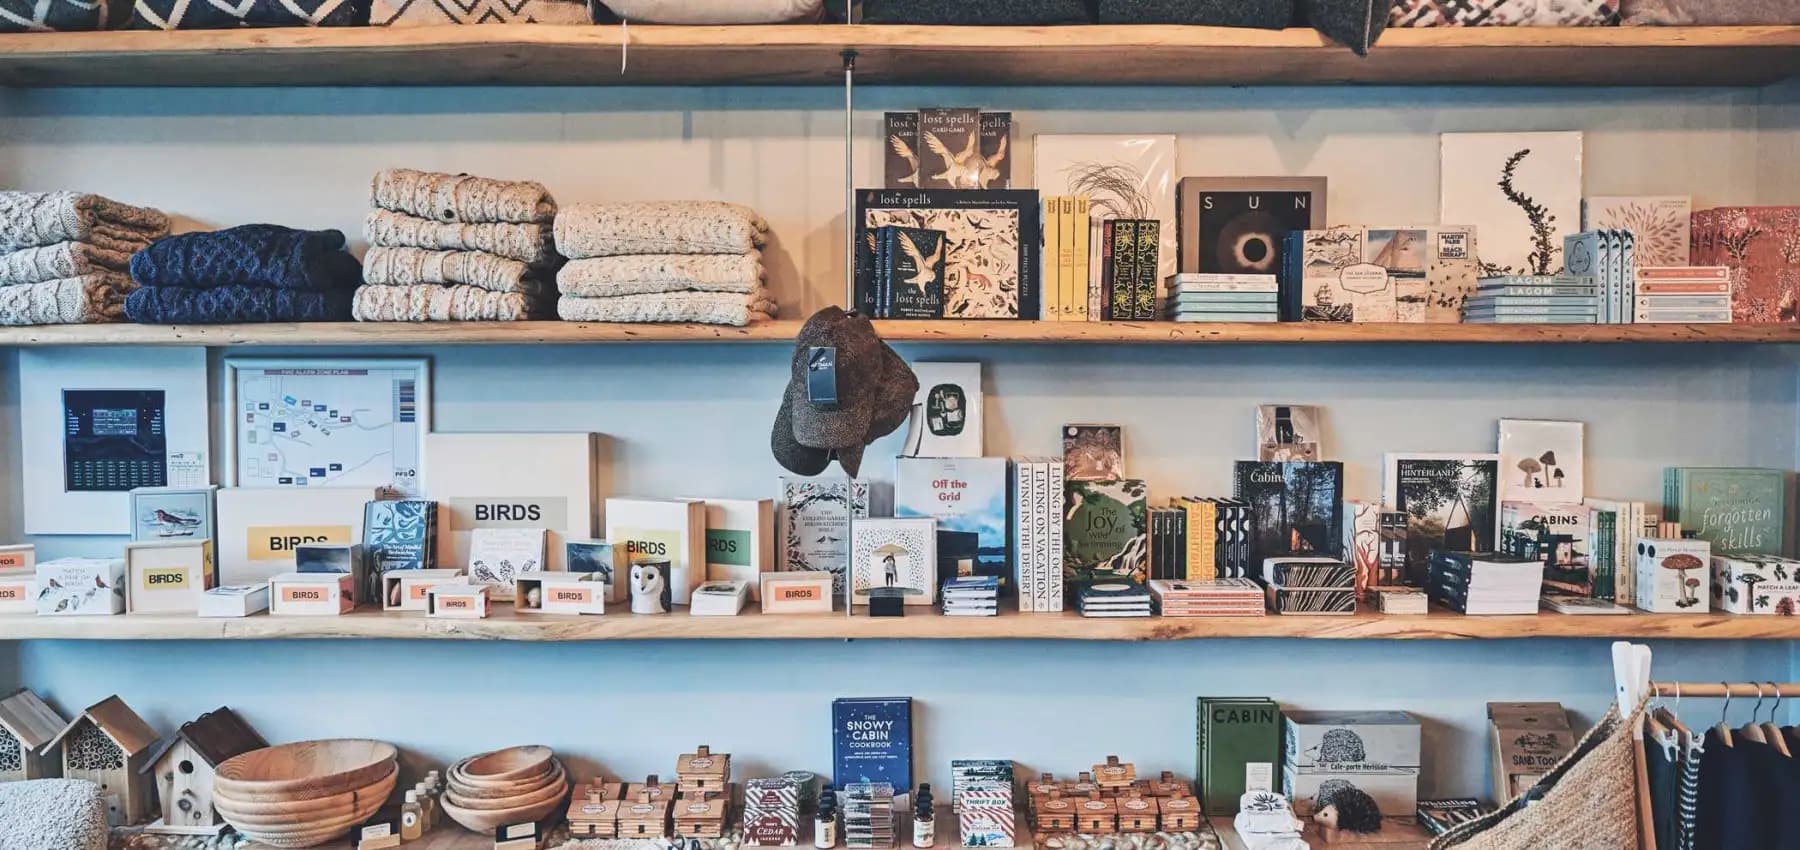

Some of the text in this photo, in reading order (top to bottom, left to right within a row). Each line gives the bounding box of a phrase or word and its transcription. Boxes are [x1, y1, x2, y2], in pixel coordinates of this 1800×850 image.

[890, 118, 908, 128] lost
[923, 113, 974, 127] lost spells
[880, 193, 931, 207] lost spells
[1203, 196, 1307, 210] SUN
[1509, 277, 1553, 285] LAGOM
[1510, 287, 1553, 296] LAGOM
[896, 292, 940, 308] lost spells
[1250, 469, 1286, 483] Cabins
[1401, 469, 1455, 477] HINTERLAND
[932, 479, 967, 489] Off the
[938, 492, 961, 502] Grid
[475, 504, 541, 521] BIRDS
[1102, 507, 1117, 516] The
[1085, 511, 1126, 535] Joy of
[1532, 515, 1578, 525] CABINS
[1696, 507, 1771, 535] forgotten
[1021, 467, 1031, 598] LIVING IN THE DESERT
[1036, 471, 1046, 600] LIVING ON VACATION
[1052, 467, 1061, 599] LIVING BY THE OCEAN
[1721, 526, 1762, 550] skills
[627, 540, 666, 556] BIRDS
[711, 538, 737, 553] RDS
[149, 573, 183, 584] BIRDS
[292, 591, 319, 599] BIRDS
[557, 592, 583, 600] BIRDS
[785, 590, 813, 598] BIRDS
[1214, 709, 1273, 723] CABIN
[847, 720, 893, 731] SNOWY
[852, 731, 889, 740] CABIN
[1512, 755, 1535, 766] SAND
[756, 827, 784, 835] CEDAR
